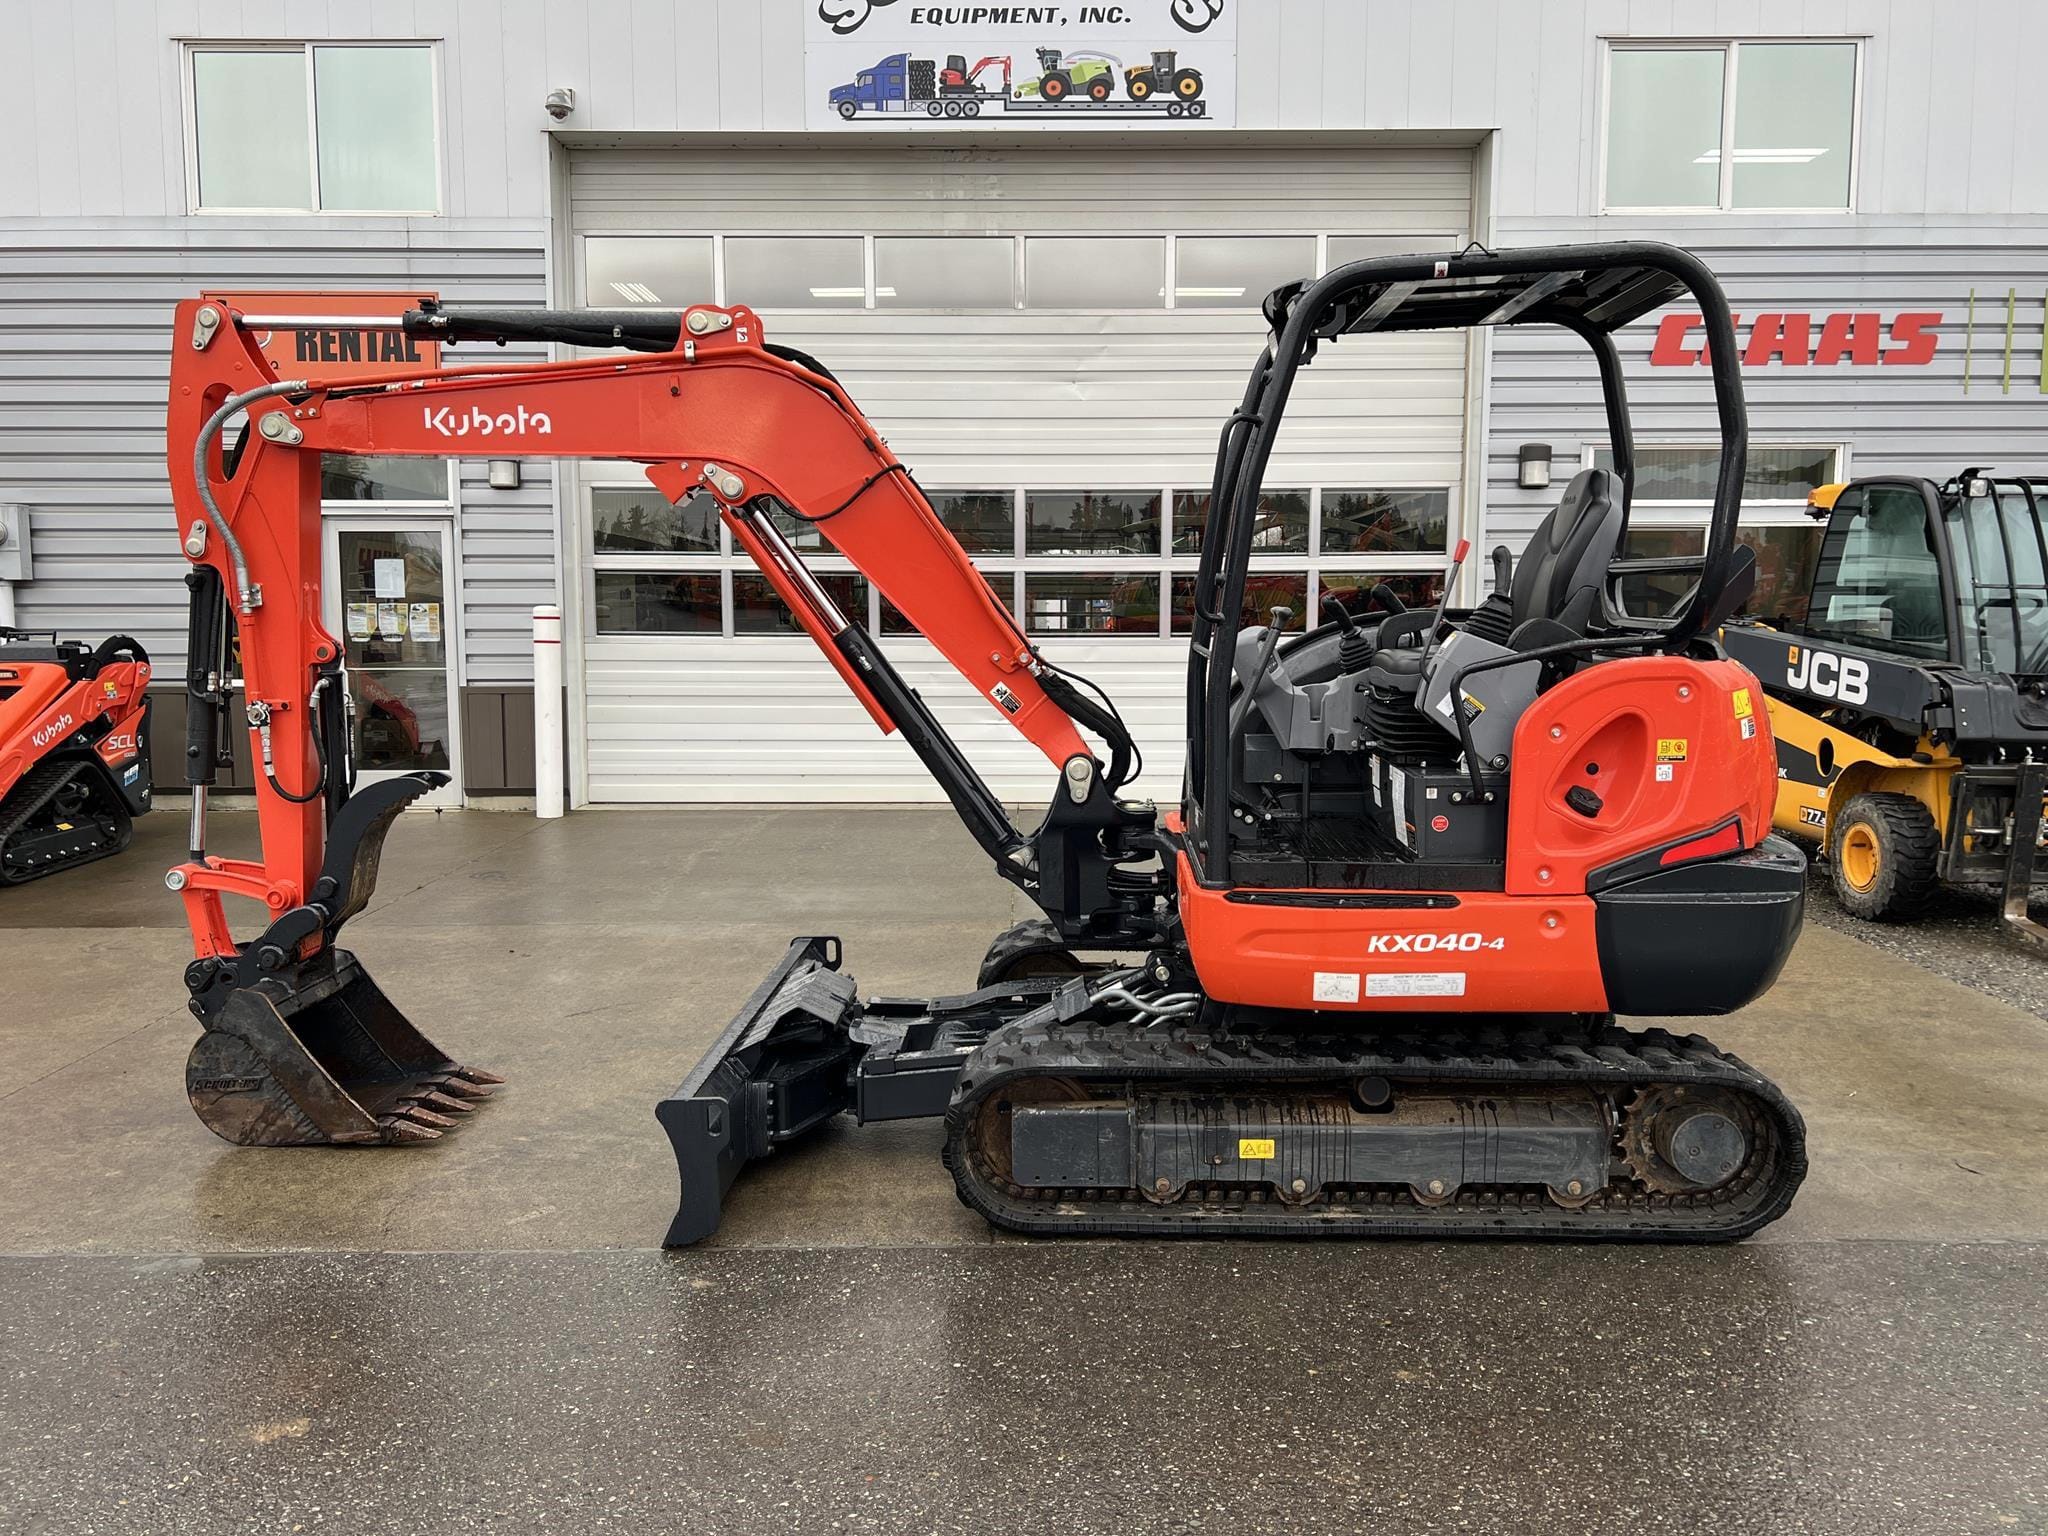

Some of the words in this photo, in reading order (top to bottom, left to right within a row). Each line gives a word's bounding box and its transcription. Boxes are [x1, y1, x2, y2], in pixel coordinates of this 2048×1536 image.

[910, 7, 1067, 26] EQUIPMENT,
[1079, 7, 1131, 24] INC.
[424, 405, 552, 436] Kubota
[1787, 649, 1869, 705] JCB
[32, 714, 73, 746] Kubota
[108, 735, 135, 750] SCL
[1368, 933, 1505, 953] KX040-4
